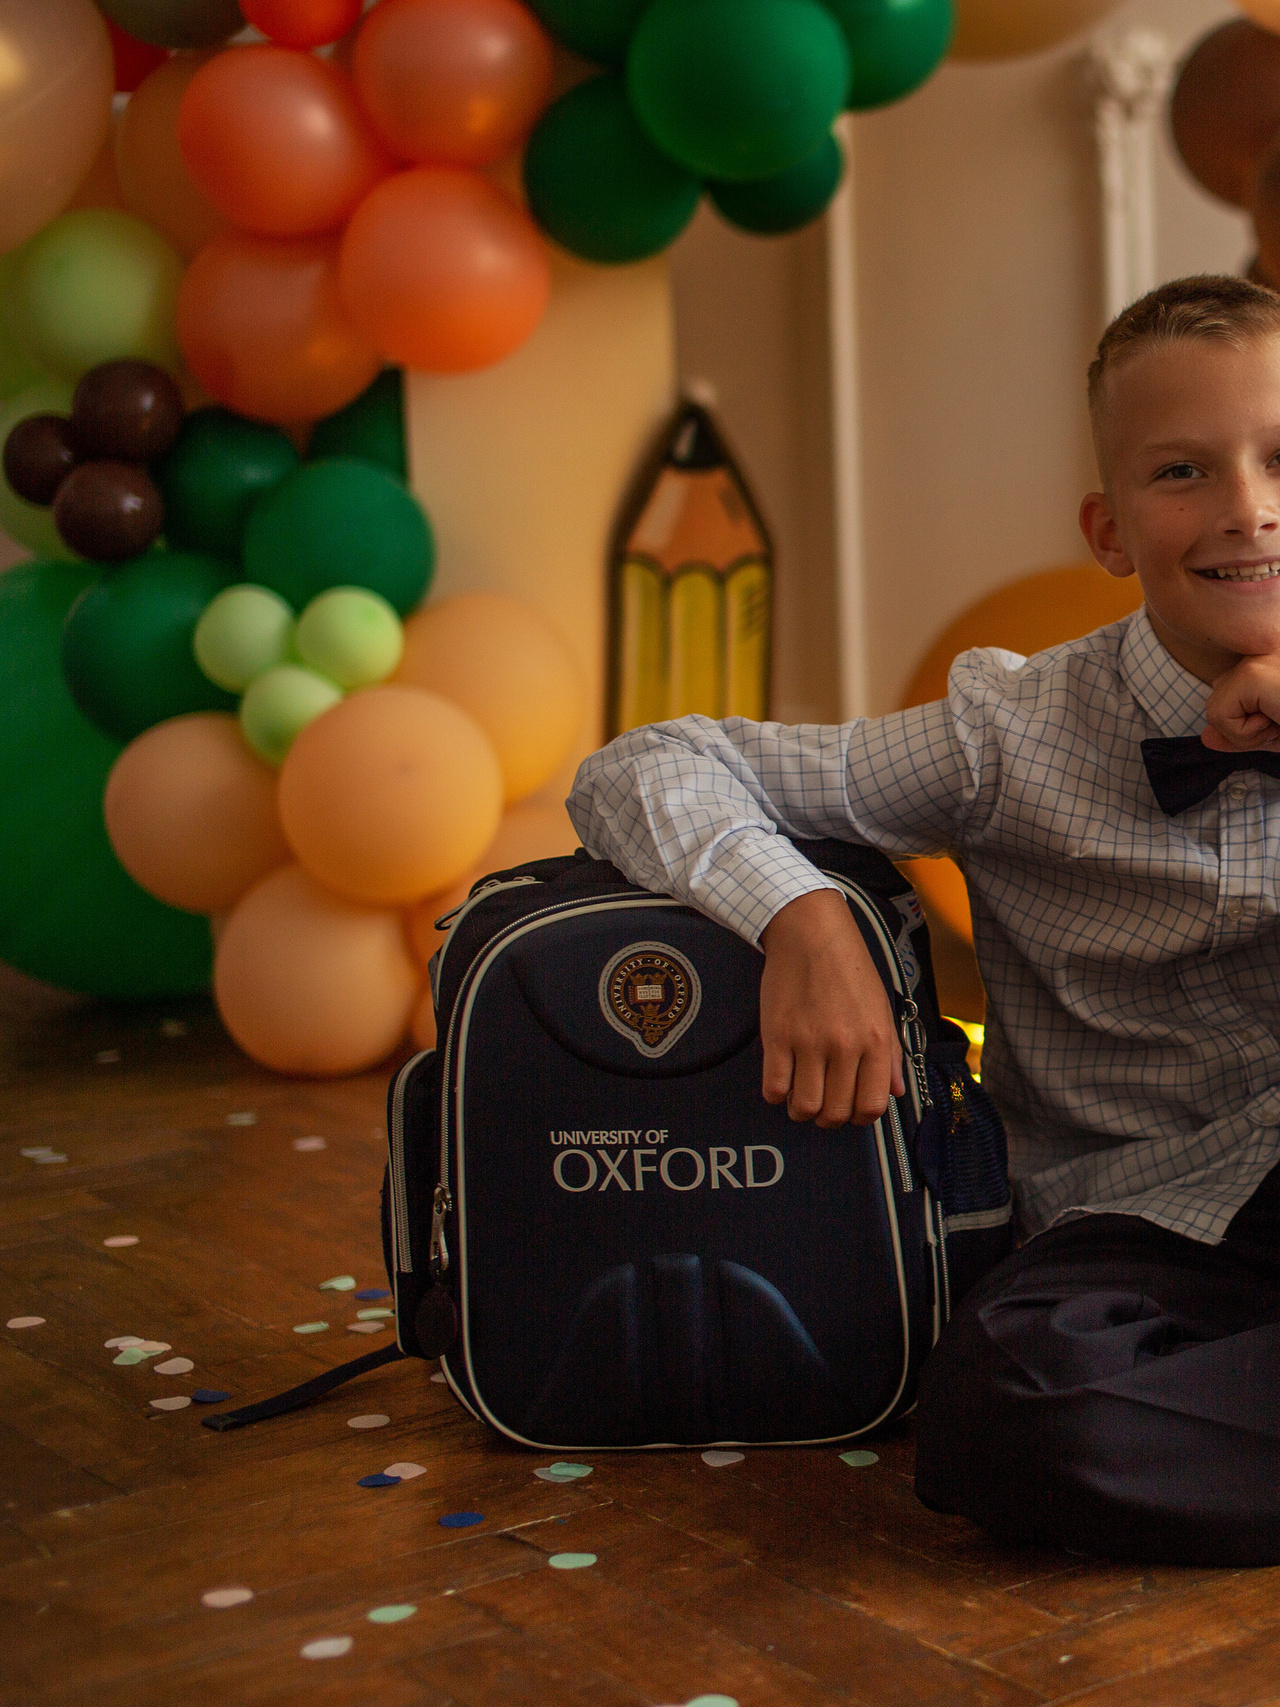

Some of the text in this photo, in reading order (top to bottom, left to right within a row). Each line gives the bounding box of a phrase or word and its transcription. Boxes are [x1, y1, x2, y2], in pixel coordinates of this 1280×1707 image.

[614, 958, 686, 1020] UNIVERSITY OF OXFORD
[550, 1129, 669, 1146] UNIVERSITY OF
[553, 1144, 785, 1193] OXFORD
